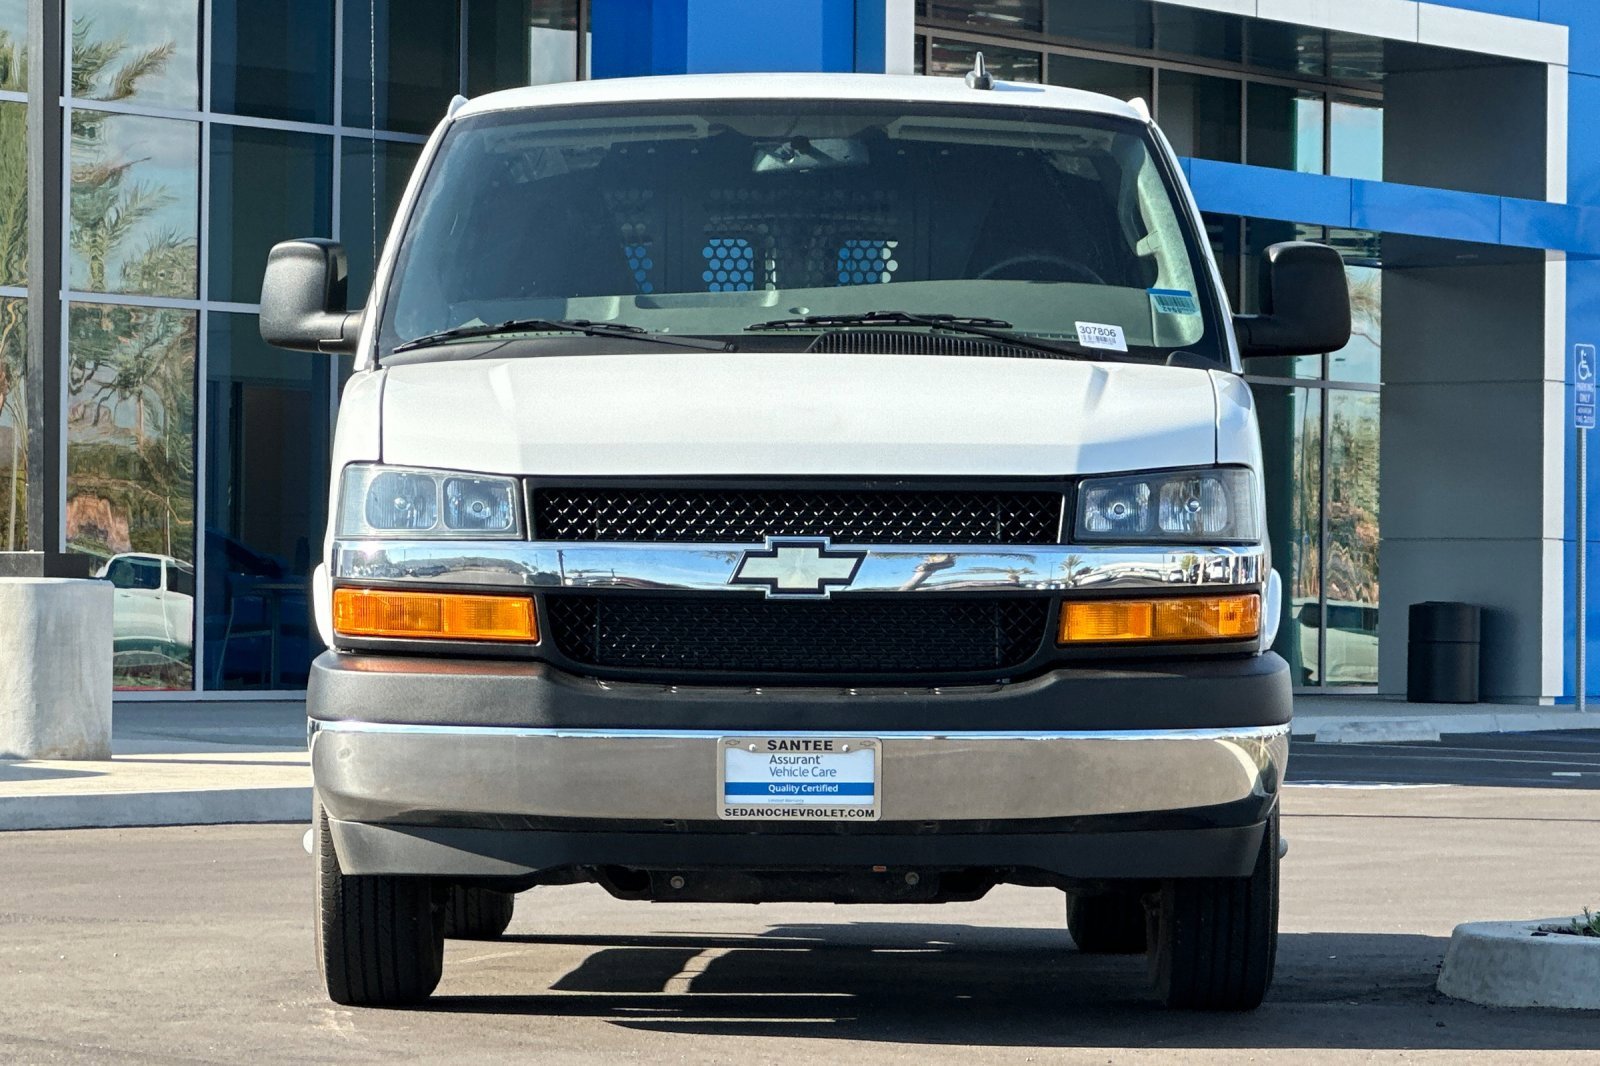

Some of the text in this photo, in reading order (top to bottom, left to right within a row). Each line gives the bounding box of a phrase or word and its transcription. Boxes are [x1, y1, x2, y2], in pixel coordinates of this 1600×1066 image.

[1079, 326, 1117, 338] 307806
[767, 740, 833, 751] SANTEE
[769, 754, 821, 765] Assurant
[769, 766, 838, 777] Vehicle Care
[768, 784, 839, 794] Quality Certified
[724, 808, 875, 818] SEDANOCHEVROLET.COM
